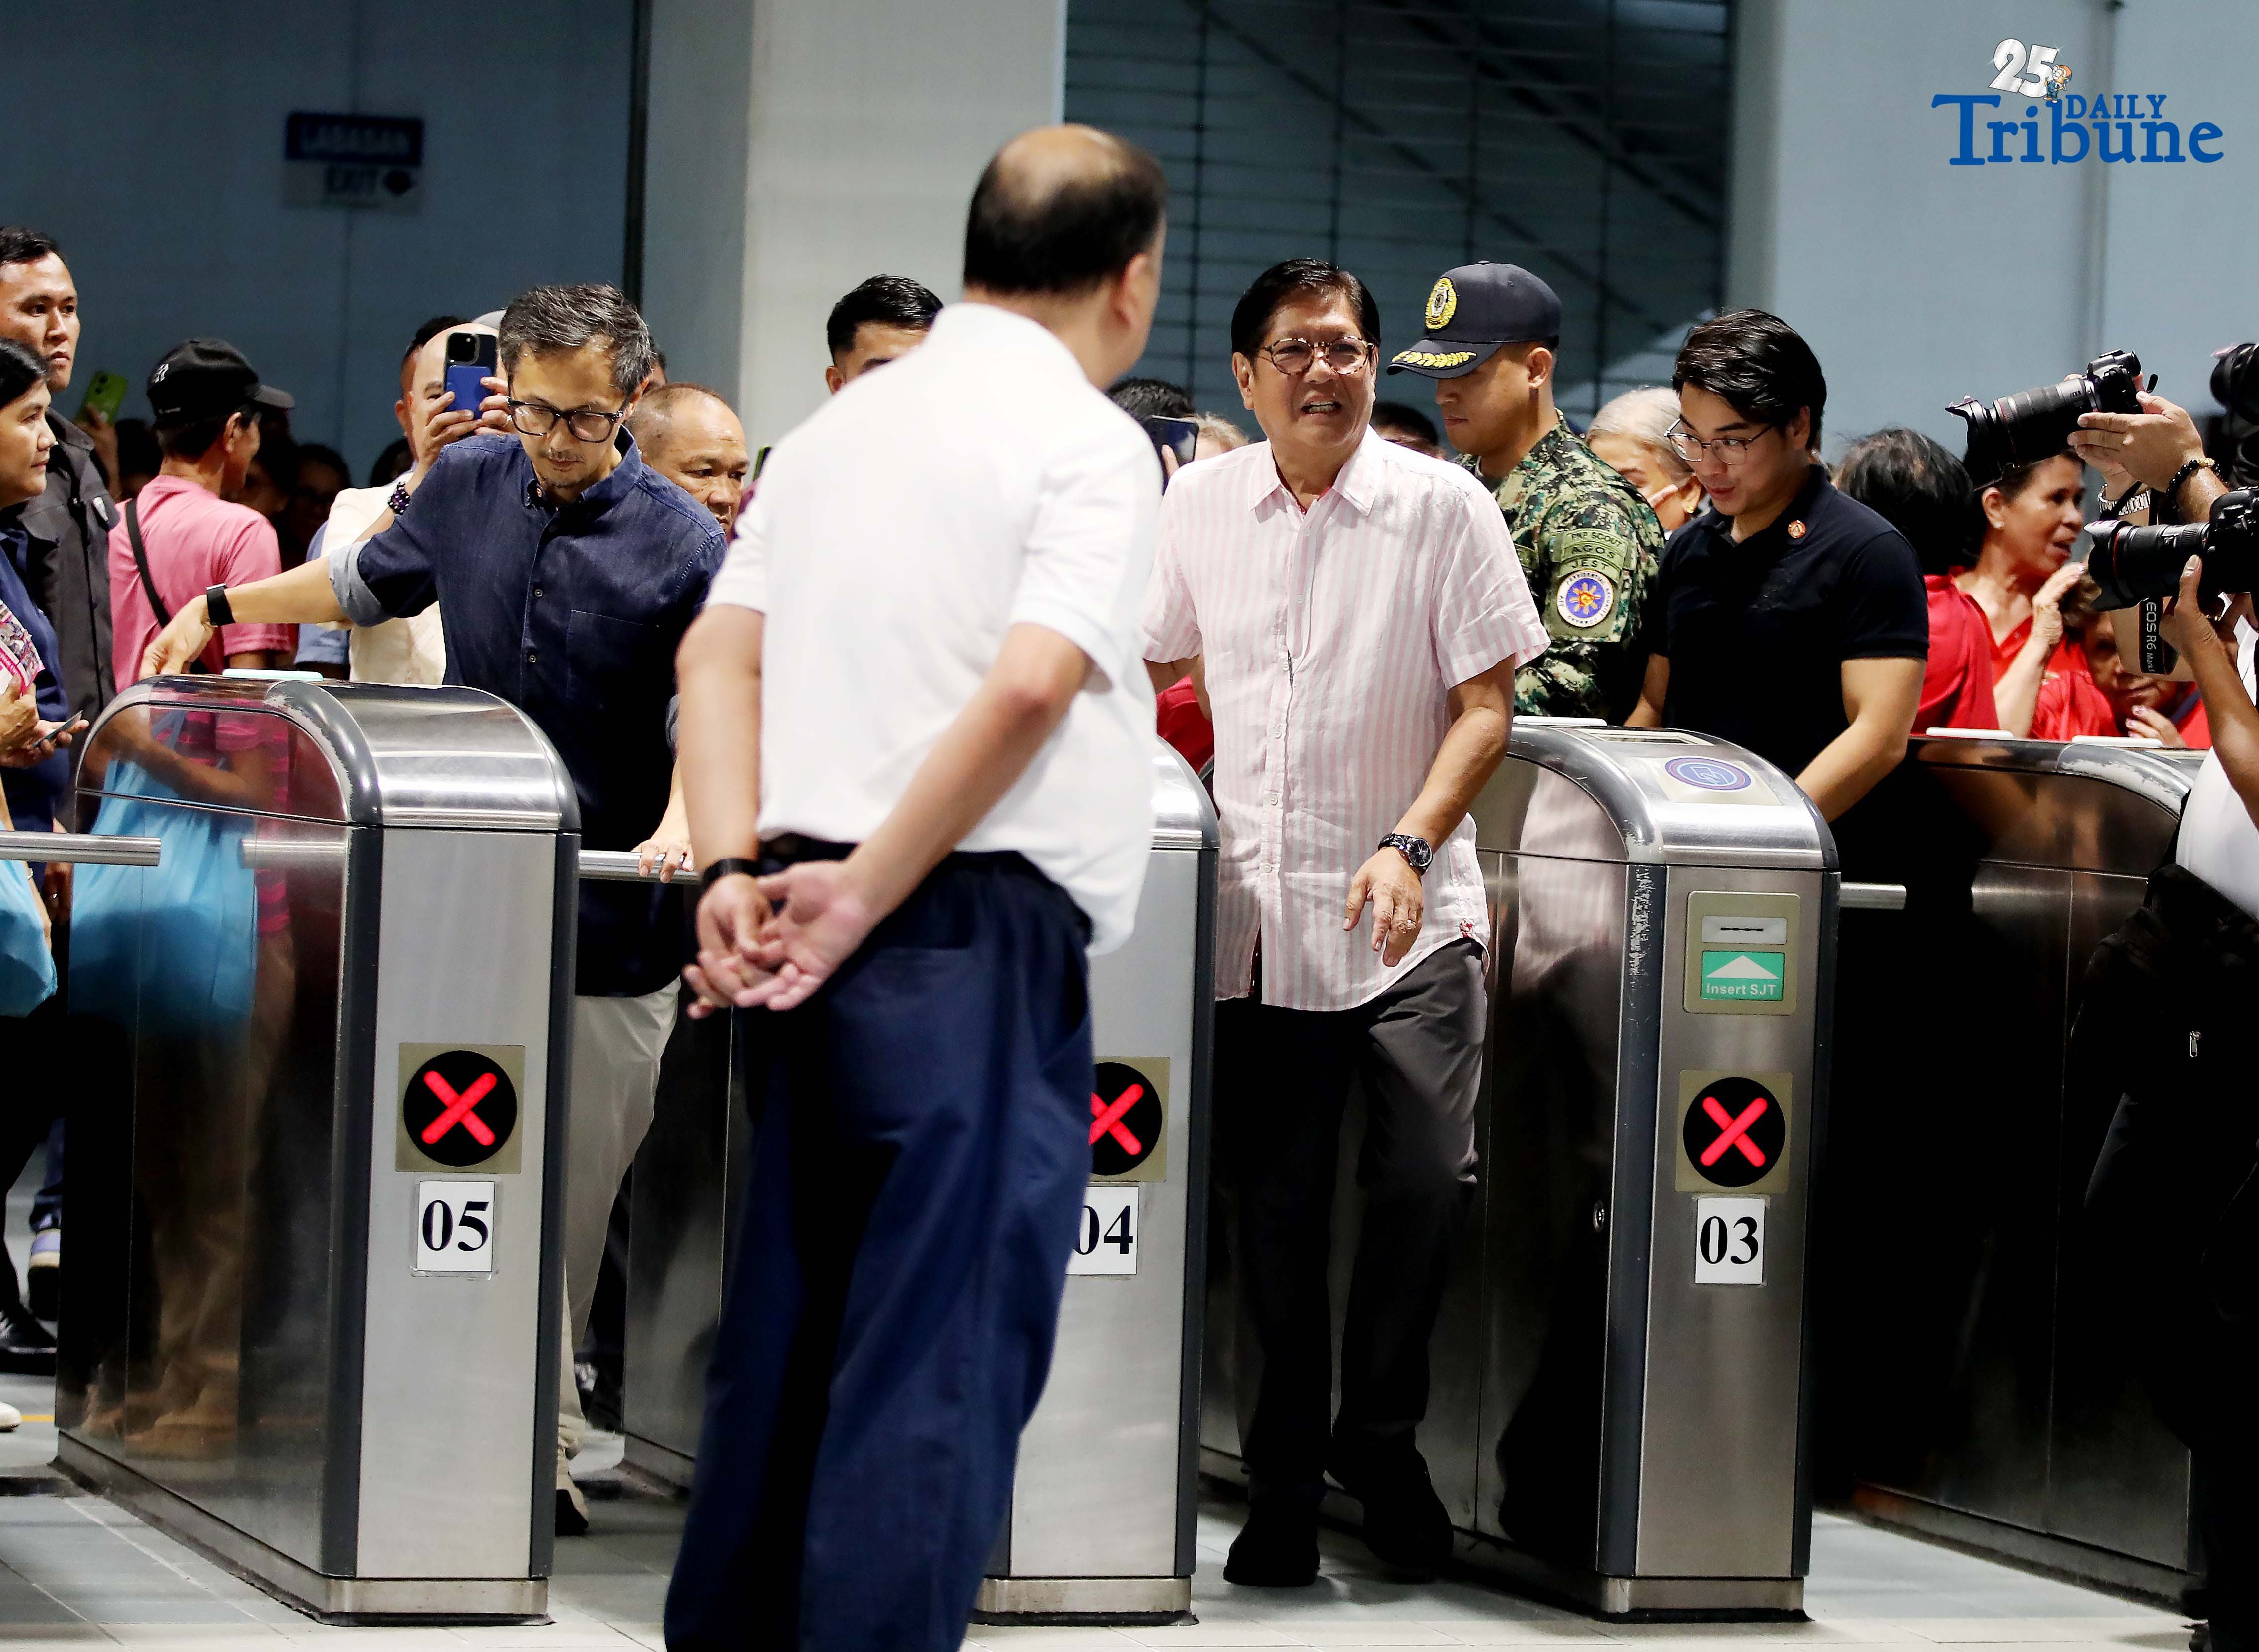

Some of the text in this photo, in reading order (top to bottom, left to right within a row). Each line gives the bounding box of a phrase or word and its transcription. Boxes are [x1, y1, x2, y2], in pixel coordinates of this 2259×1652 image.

[1591, 532, 1622, 547] SCOUT
[1571, 545, 1615, 559] AGOS
[1571, 560, 1609, 570] JEST
[2146, 602, 2157, 632] EOS
[2146, 635, 2157, 650] R6
[1707, 983, 1776, 996] Insert SJT
[422, 1200, 490, 1252] 05
[1073, 1205, 1133, 1255] 04
[1700, 1216, 1759, 1265] 03
